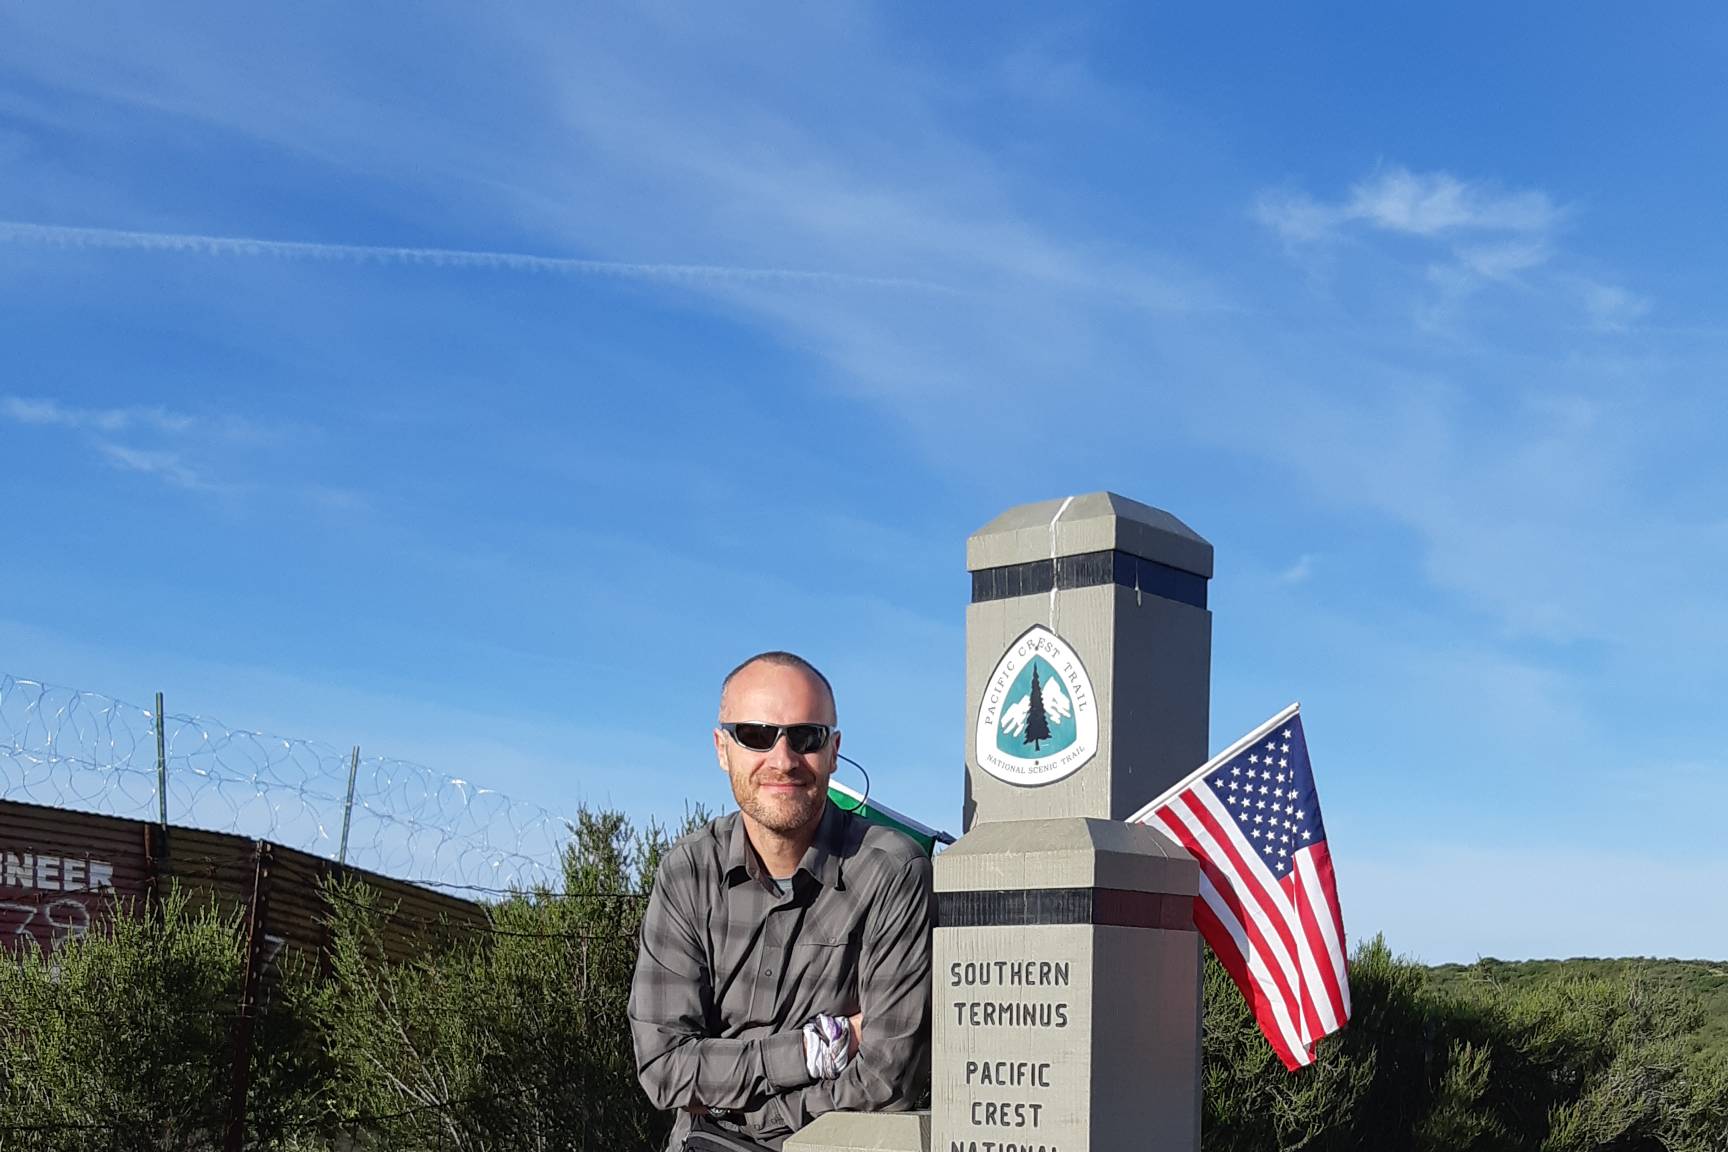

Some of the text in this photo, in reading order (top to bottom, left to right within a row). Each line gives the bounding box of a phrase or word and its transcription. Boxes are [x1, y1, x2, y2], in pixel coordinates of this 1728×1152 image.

[985, 638, 1088, 725] PACIFIC CREST TRAIL
[986, 745, 1086, 774] NATIONAL SCENIC TRAIL
[0, 851, 115, 894] NEER
[950, 961, 1070, 987] SOUTHERN
[953, 1002, 1068, 1028] TERMINUS
[966, 1060, 1051, 1088] PACIFIC
[971, 1101, 1043, 1128] CREST
